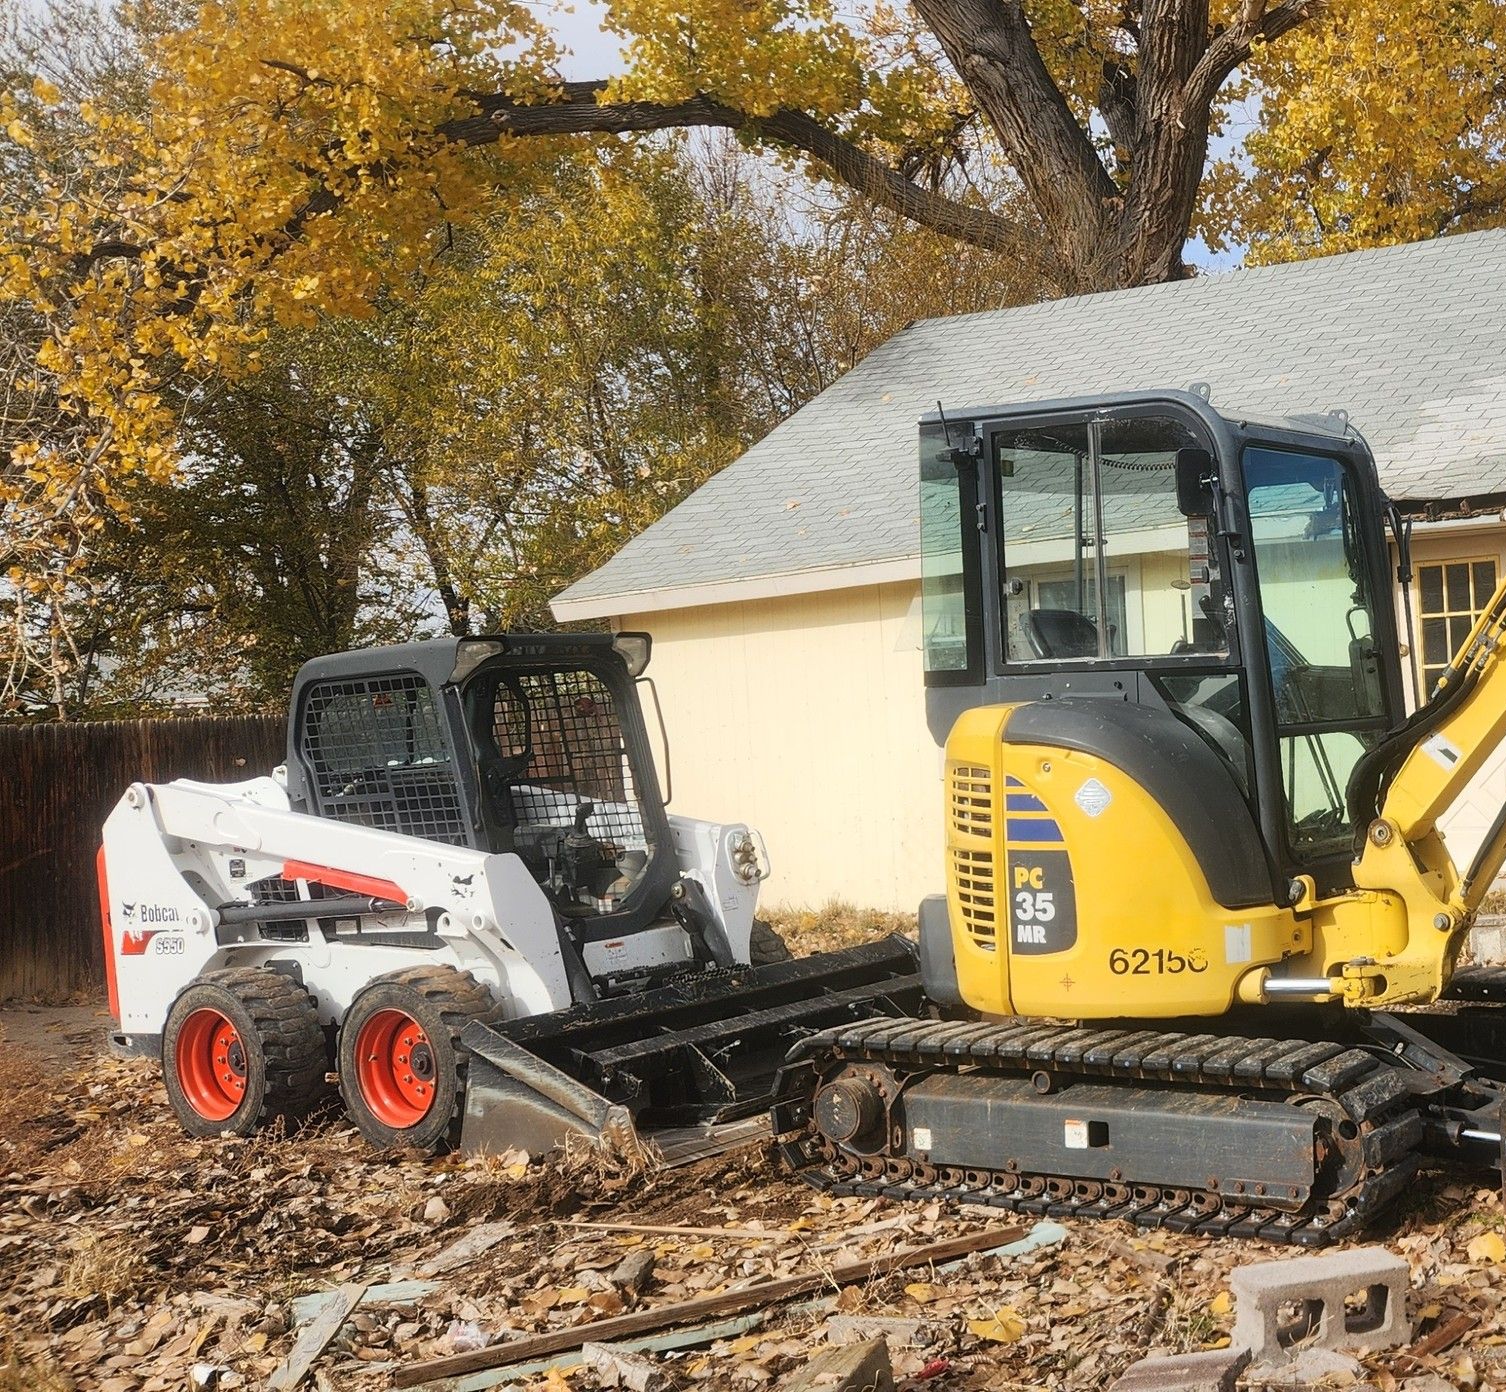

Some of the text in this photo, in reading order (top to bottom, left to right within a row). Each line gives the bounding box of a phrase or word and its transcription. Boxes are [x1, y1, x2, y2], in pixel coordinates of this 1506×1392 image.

[1014, 866, 1043, 889] PC
[1015, 891, 1056, 922] 35
[1017, 924, 1047, 943] MR
